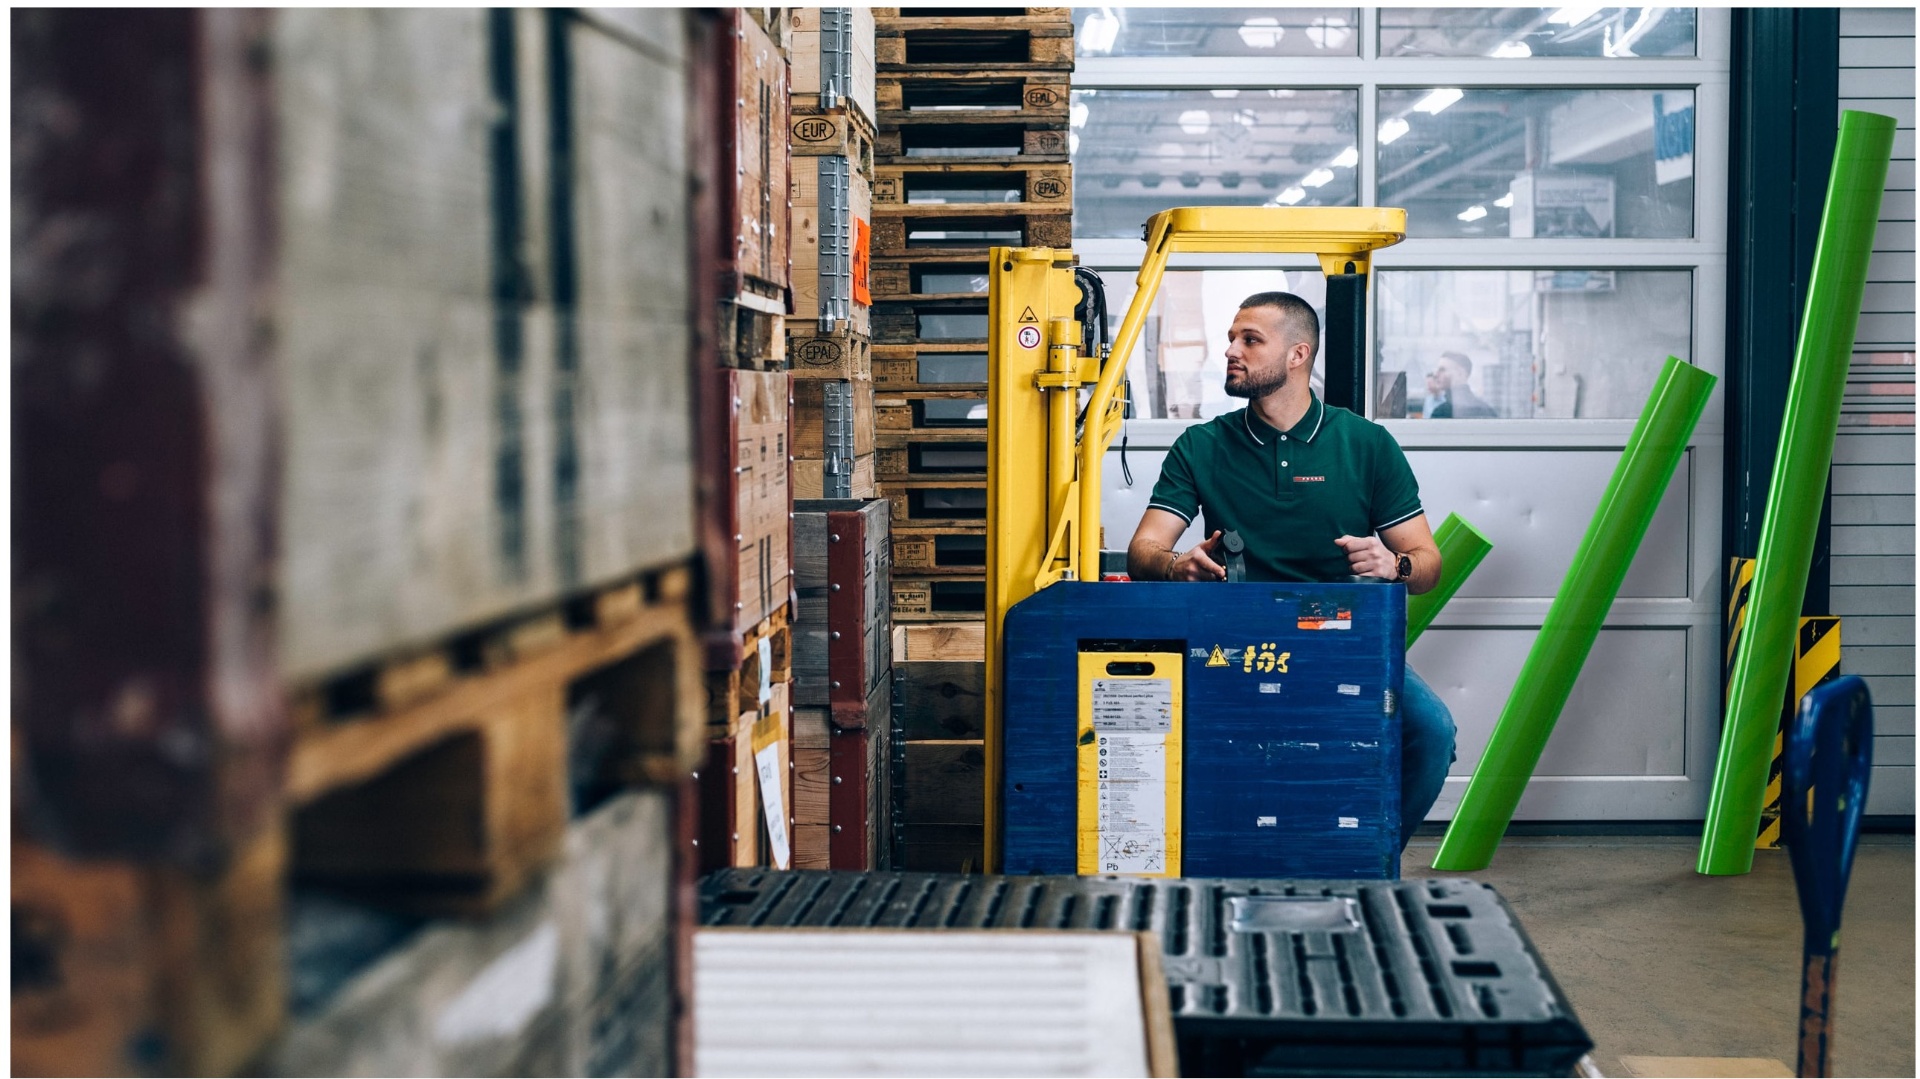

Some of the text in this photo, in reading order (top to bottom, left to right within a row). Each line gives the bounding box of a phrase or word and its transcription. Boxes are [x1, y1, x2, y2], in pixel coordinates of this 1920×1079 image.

[1030, 92, 1053, 104] EPAL
[802, 122, 827, 138] EUR
[1040, 137, 1059, 150] EUR
[1038, 182, 1061, 194] EPAL
[806, 345, 835, 360] EPAL
[1106, 862, 1119, 871] Pb
